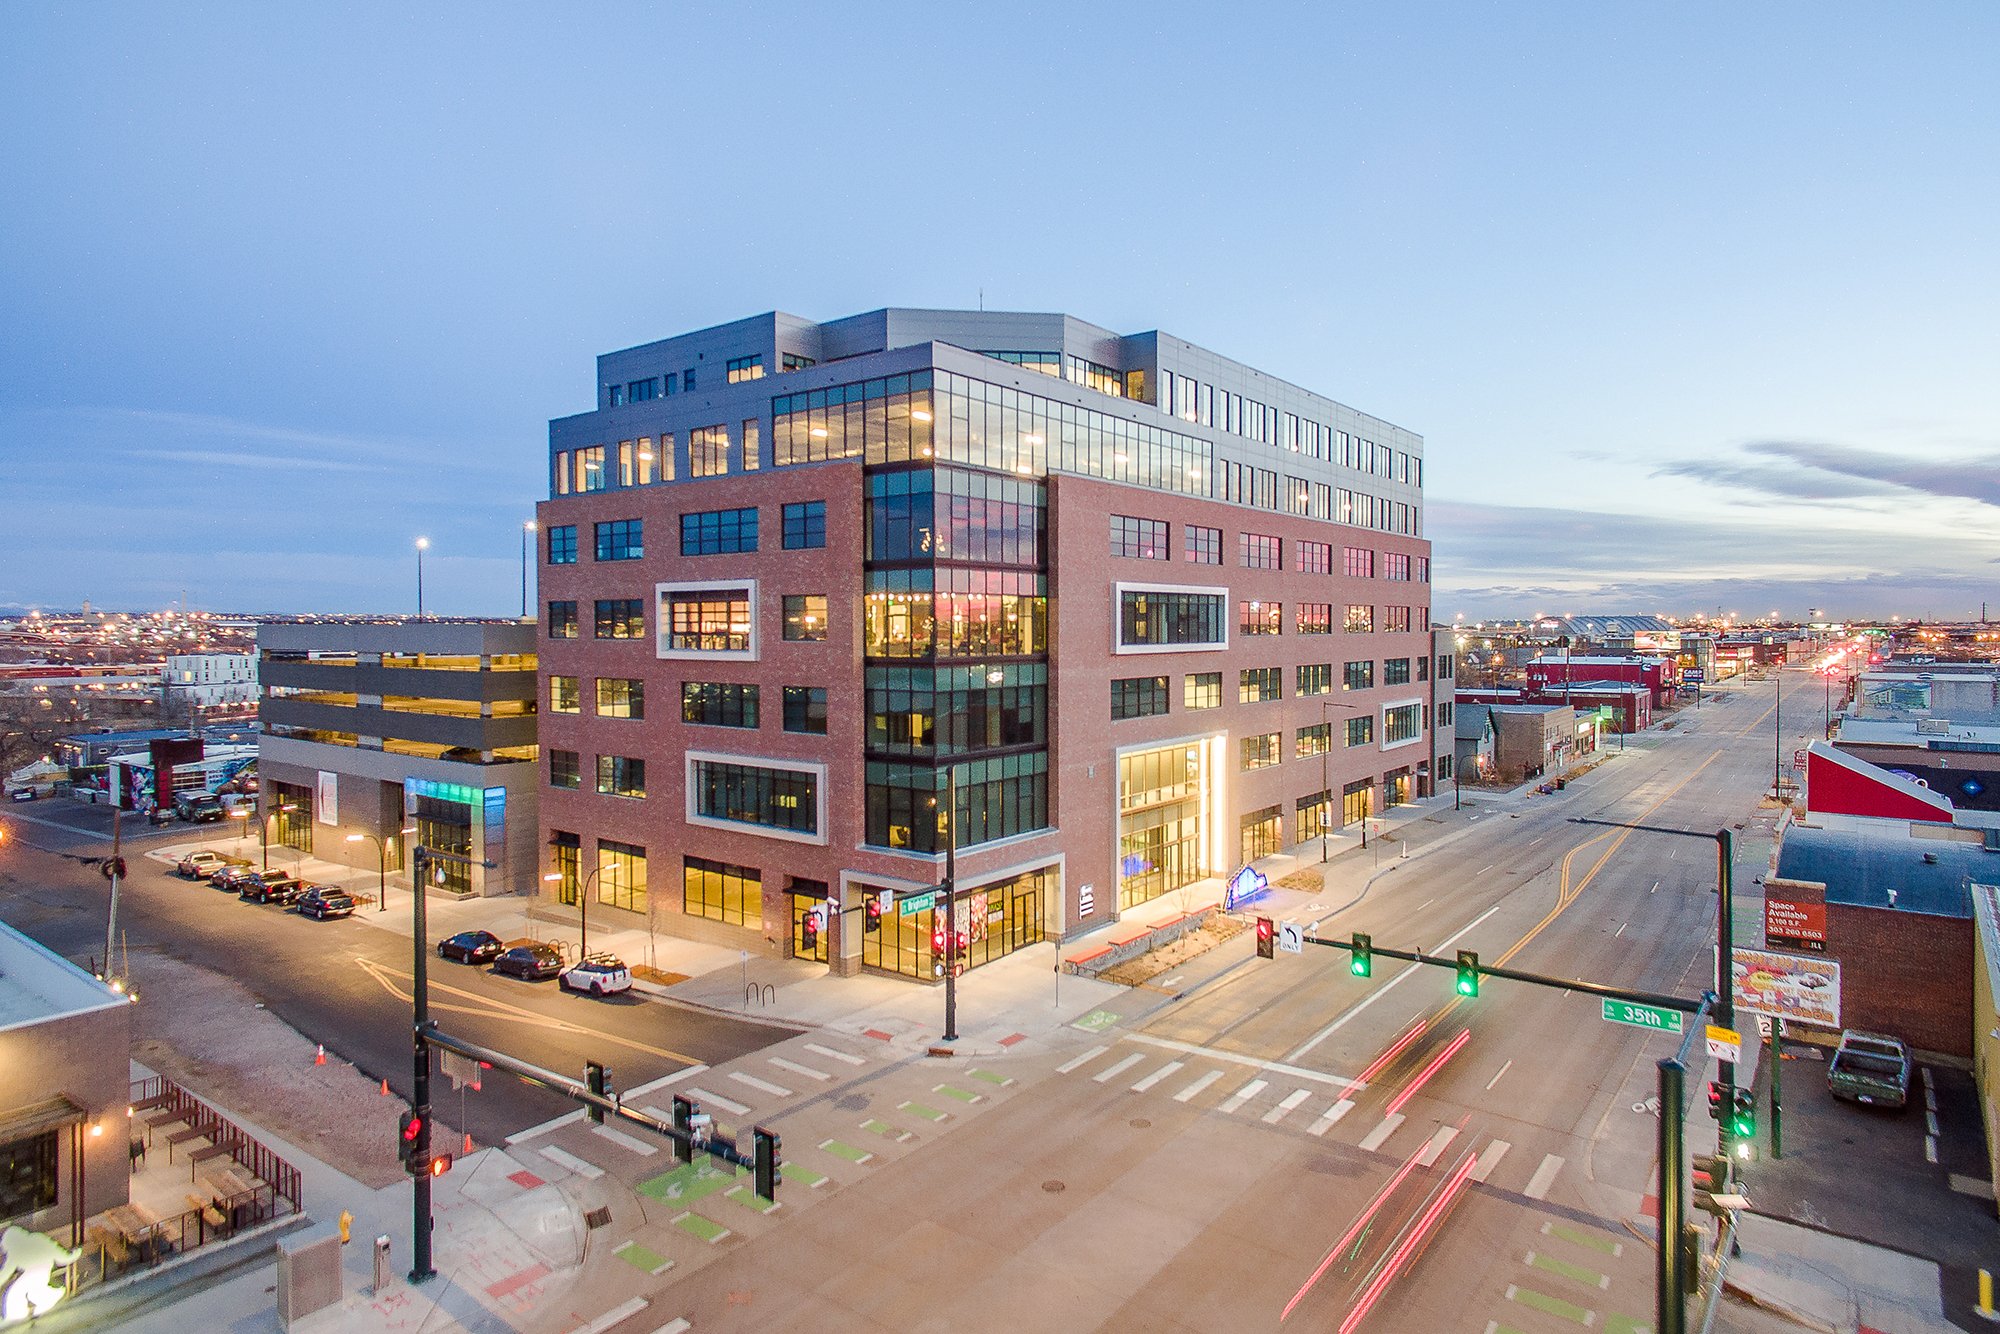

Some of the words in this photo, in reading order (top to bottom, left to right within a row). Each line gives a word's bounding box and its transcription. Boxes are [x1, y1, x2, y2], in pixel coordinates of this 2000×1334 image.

[907, 897, 929, 913] Brighton
[1768, 900, 1795, 911] Space
[1768, 908, 1808, 921] Available
[1768, 926, 1783, 934] 303
[1282, 943, 1299, 951] ONLY
[1623, 1006, 1662, 1027] 35th
